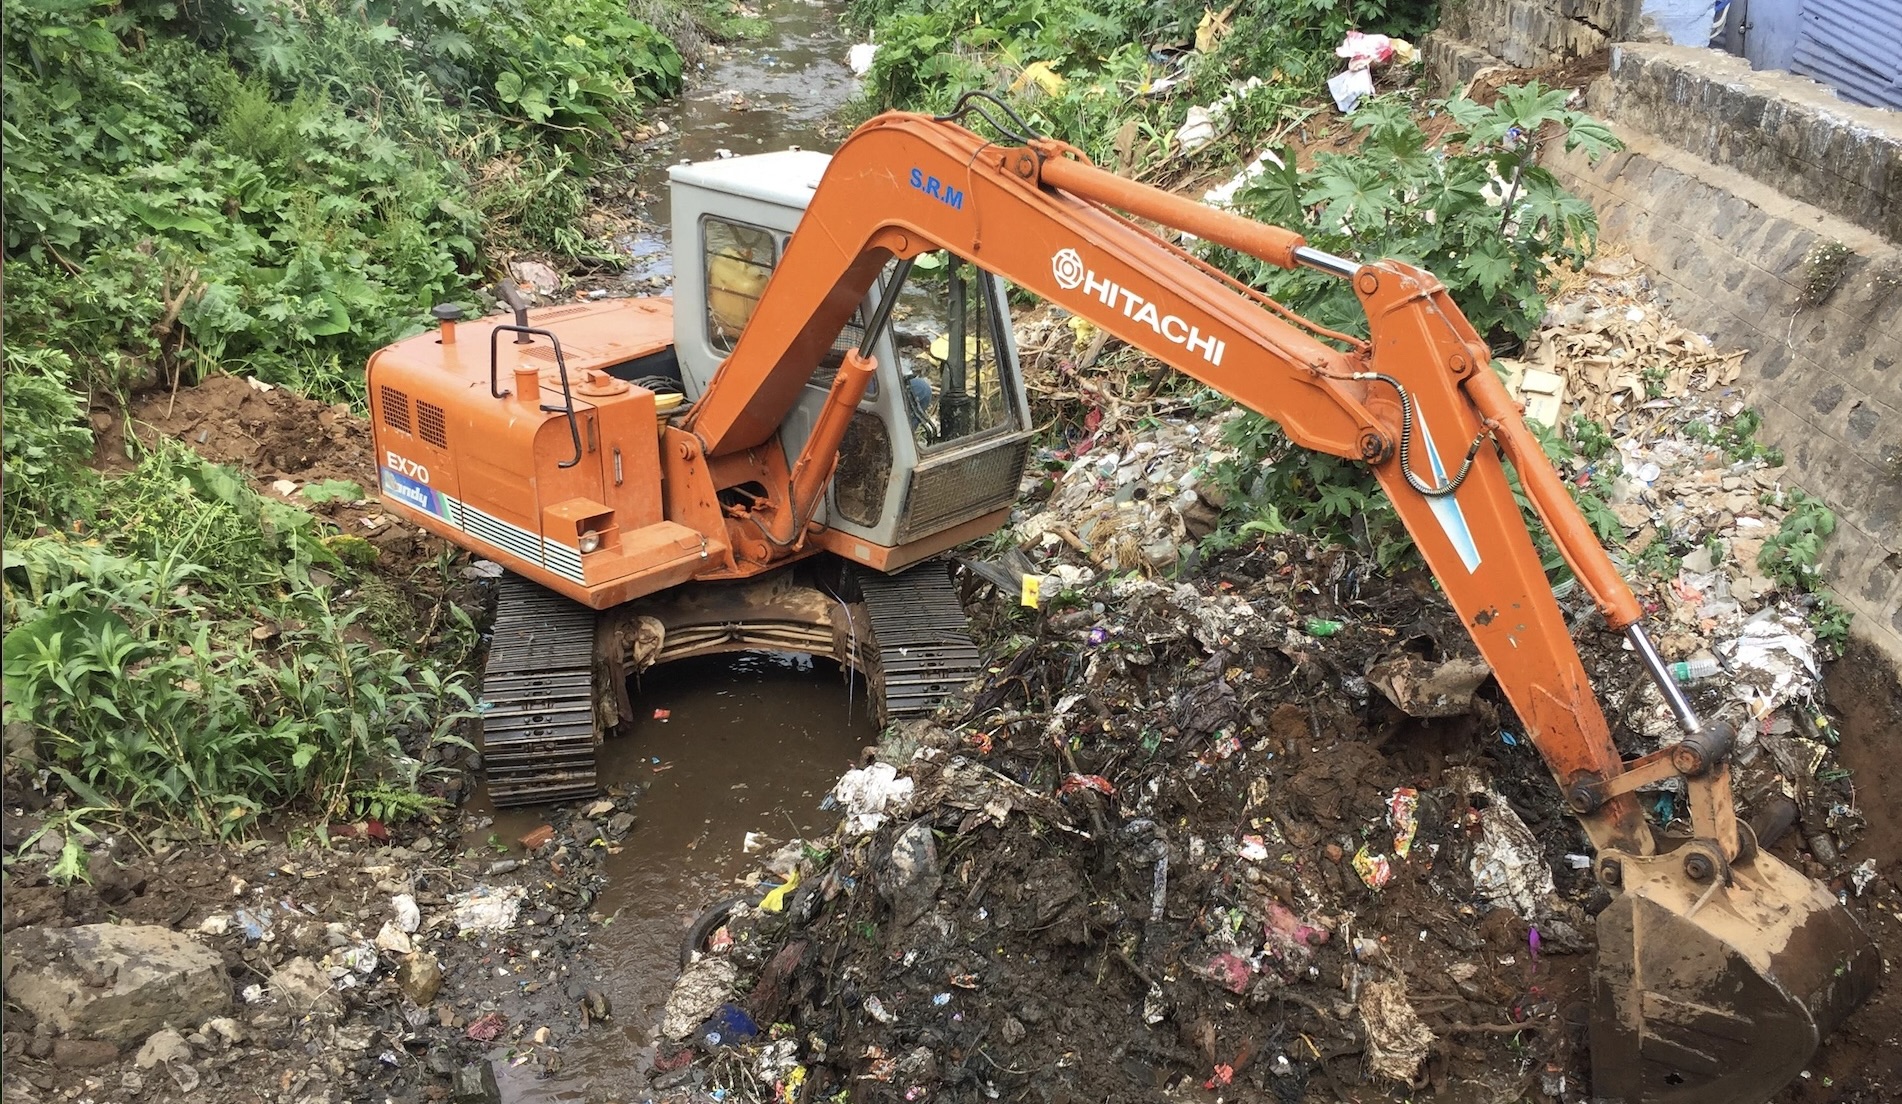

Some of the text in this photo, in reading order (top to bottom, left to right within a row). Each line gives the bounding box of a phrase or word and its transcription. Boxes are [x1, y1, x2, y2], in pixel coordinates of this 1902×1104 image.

[910, 168, 963, 210] S.R.M
[1084, 270, 1225, 366] HITACHI
[386, 451, 430, 484] EX70
